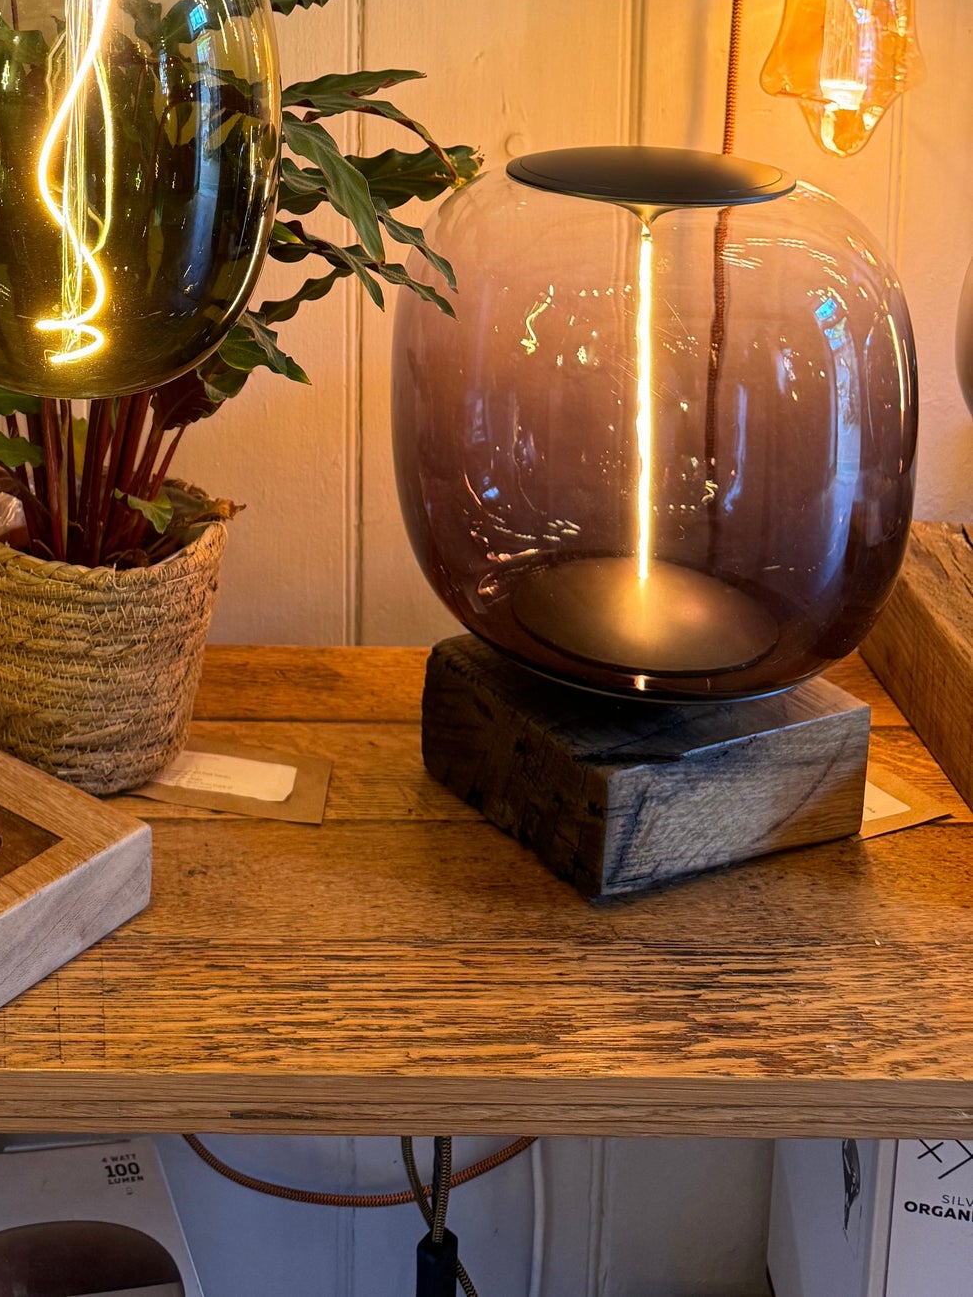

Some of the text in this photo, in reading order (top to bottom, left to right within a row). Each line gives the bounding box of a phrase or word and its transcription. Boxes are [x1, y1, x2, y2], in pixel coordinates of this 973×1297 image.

[110, 1153, 136, 1162] WATT
[104, 1162, 140, 1178] 100
[107, 1175, 144, 1185] LUMEN
[904, 1201, 973, 1222] ORGAN
